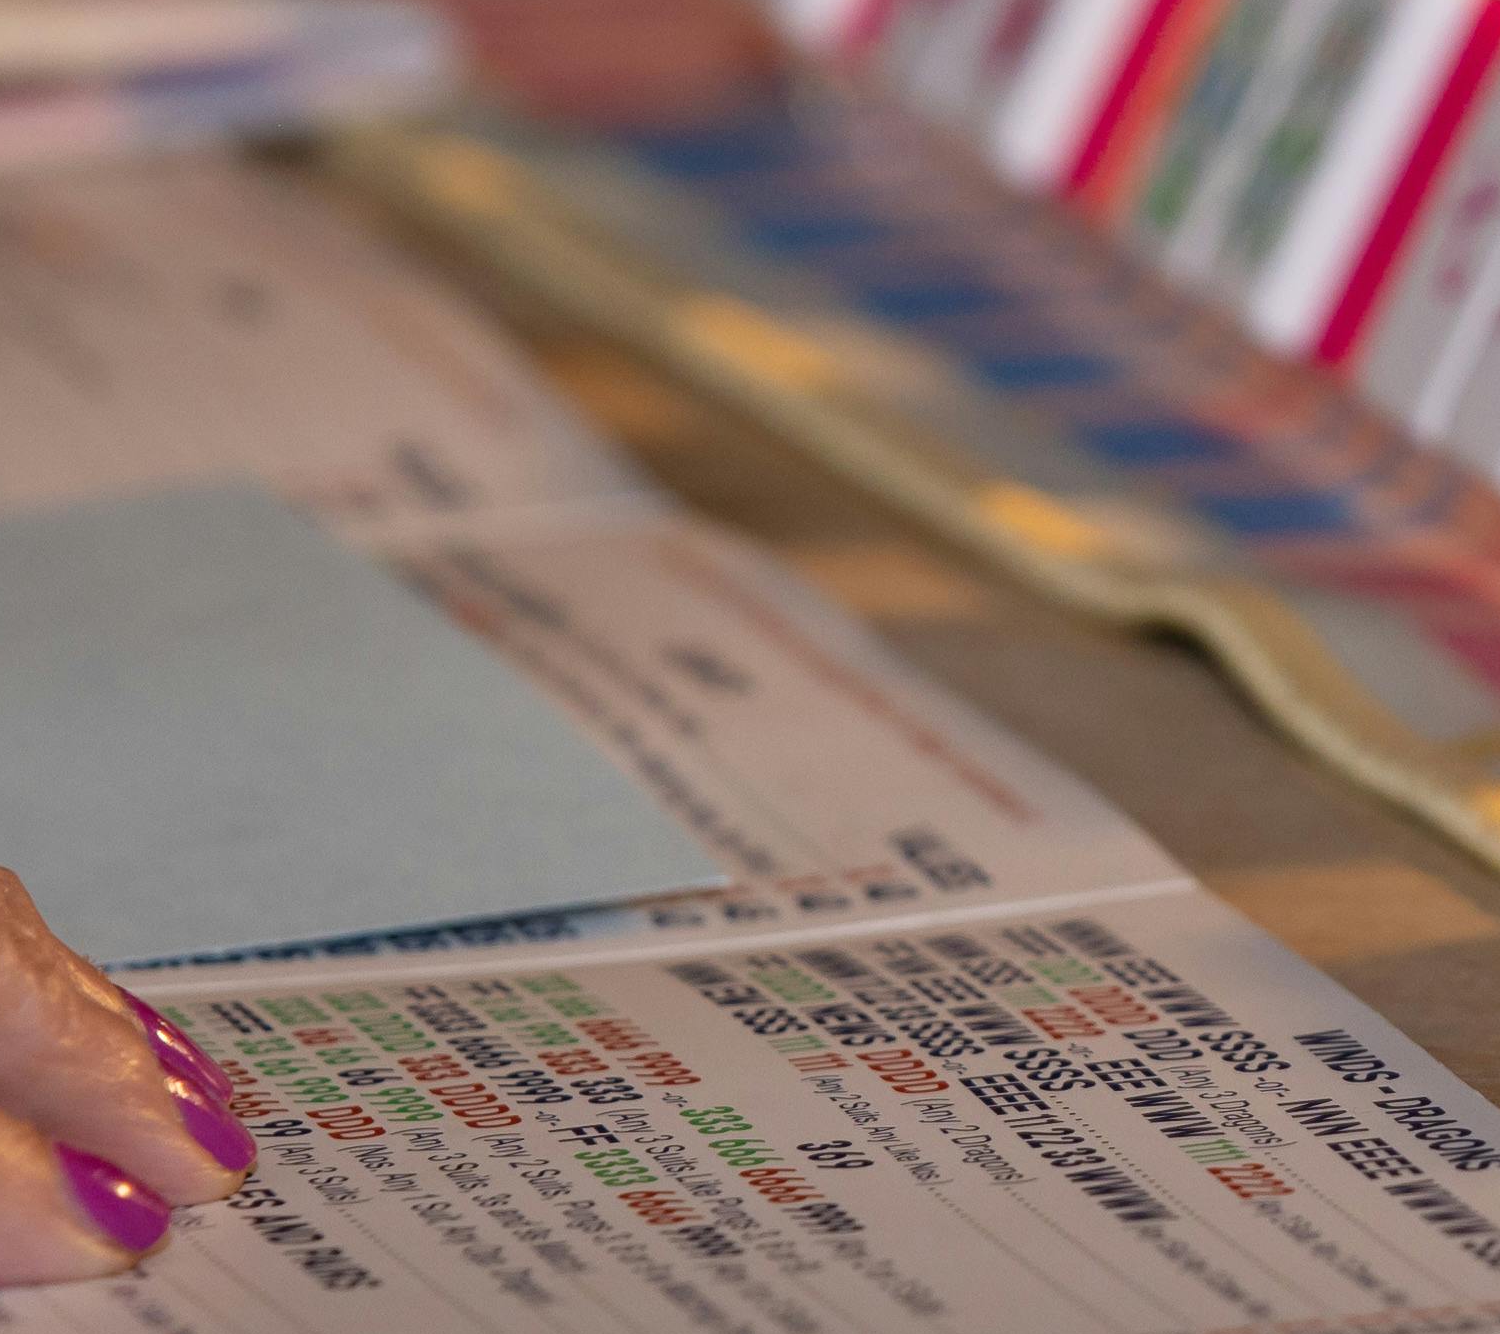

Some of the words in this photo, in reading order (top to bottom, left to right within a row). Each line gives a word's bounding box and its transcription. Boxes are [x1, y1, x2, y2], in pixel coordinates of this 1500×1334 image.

[731, 1007, 810, 1035] SSS
[806, 1004, 898, 1047] NEWS
[445, 1035, 531, 1069] 6666
[895, 1020, 987, 1058] SSSS
[1121, 1028, 1207, 1062] DDD
[251, 1057, 318, 1077] 66
[395, 1053, 473, 1082] 333
[535, 1048, 612, 1076] 333
[615, 1051, 704, 1087] 9999
[786, 1052, 854, 1073] 111
[853, 1048, 953, 1094] DDDD
[999, 1047, 1099, 1092] SSSS
[1290, 1029, 1403, 1083] WINDS
[274, 1076, 352, 1104] 999
[335, 1067, 404, 1087] 66
[487, 1069, 575, 1105] 9999
[799, 1074, 851, 1095] (Any
[1082, 1058, 1170, 1092] EEE
[1157, 1064, 1223, 1090] (Any
[357, 1086, 447, 1123] 9999
[568, 1076, 646, 1105] 333
[955, 1073, 1054, 1116] EEEE
[1196, 1030, 1293, 1073] SSSS
[1275, 1098, 1371, 1137] NNN
[1325, 1137, 1425, 1180] EEEE
[426, 1083, 525, 1129] DDDD
[677, 1105, 756, 1135] 333
[898, 1097, 967, 1124] (Any
[1001, 1113, 1065, 1129] 11
[1120, 1090, 1227, 1139] WWW
[246, 1119, 315, 1138] 99
[303, 1105, 390, 1141] DDD
[547, 1124, 622, 1146] FF
[594, 1108, 660, 1135] (Any
[856, 1125, 906, 1143] Any
[1204, 1099, 1299, 1149] Dragons)
[388, 1126, 454, 1152] (Any
[470, 1132, 535, 1159] (Any
[705, 1137, 787, 1167] 666
[880, 1142, 924, 1163] Like
[1014, 1127, 1087, 1149] 22
[1176, 1138, 1252, 1165] 1111
[260, 1142, 322, 1166] (Any
[336, 1143, 401, 1173] (Nos.
[570, 1148, 662, 1187] 3333
[794, 1139, 876, 1170] 369
[942, 1134, 1036, 1184] Dragons)
[1039, 1147, 1109, 1168] 33
[302, 1175, 365, 1204] Suits)
[371, 1171, 428, 1193] Any
[432, 1161, 498, 1193] Suits,
[514, 1168, 581, 1201] Suits,
[735, 1167, 827, 1204] 6666
[1204, 1163, 1296, 1199] 2222
[615, 1189, 699, 1226] 6666
[248, 1213, 326, 1245] AND
